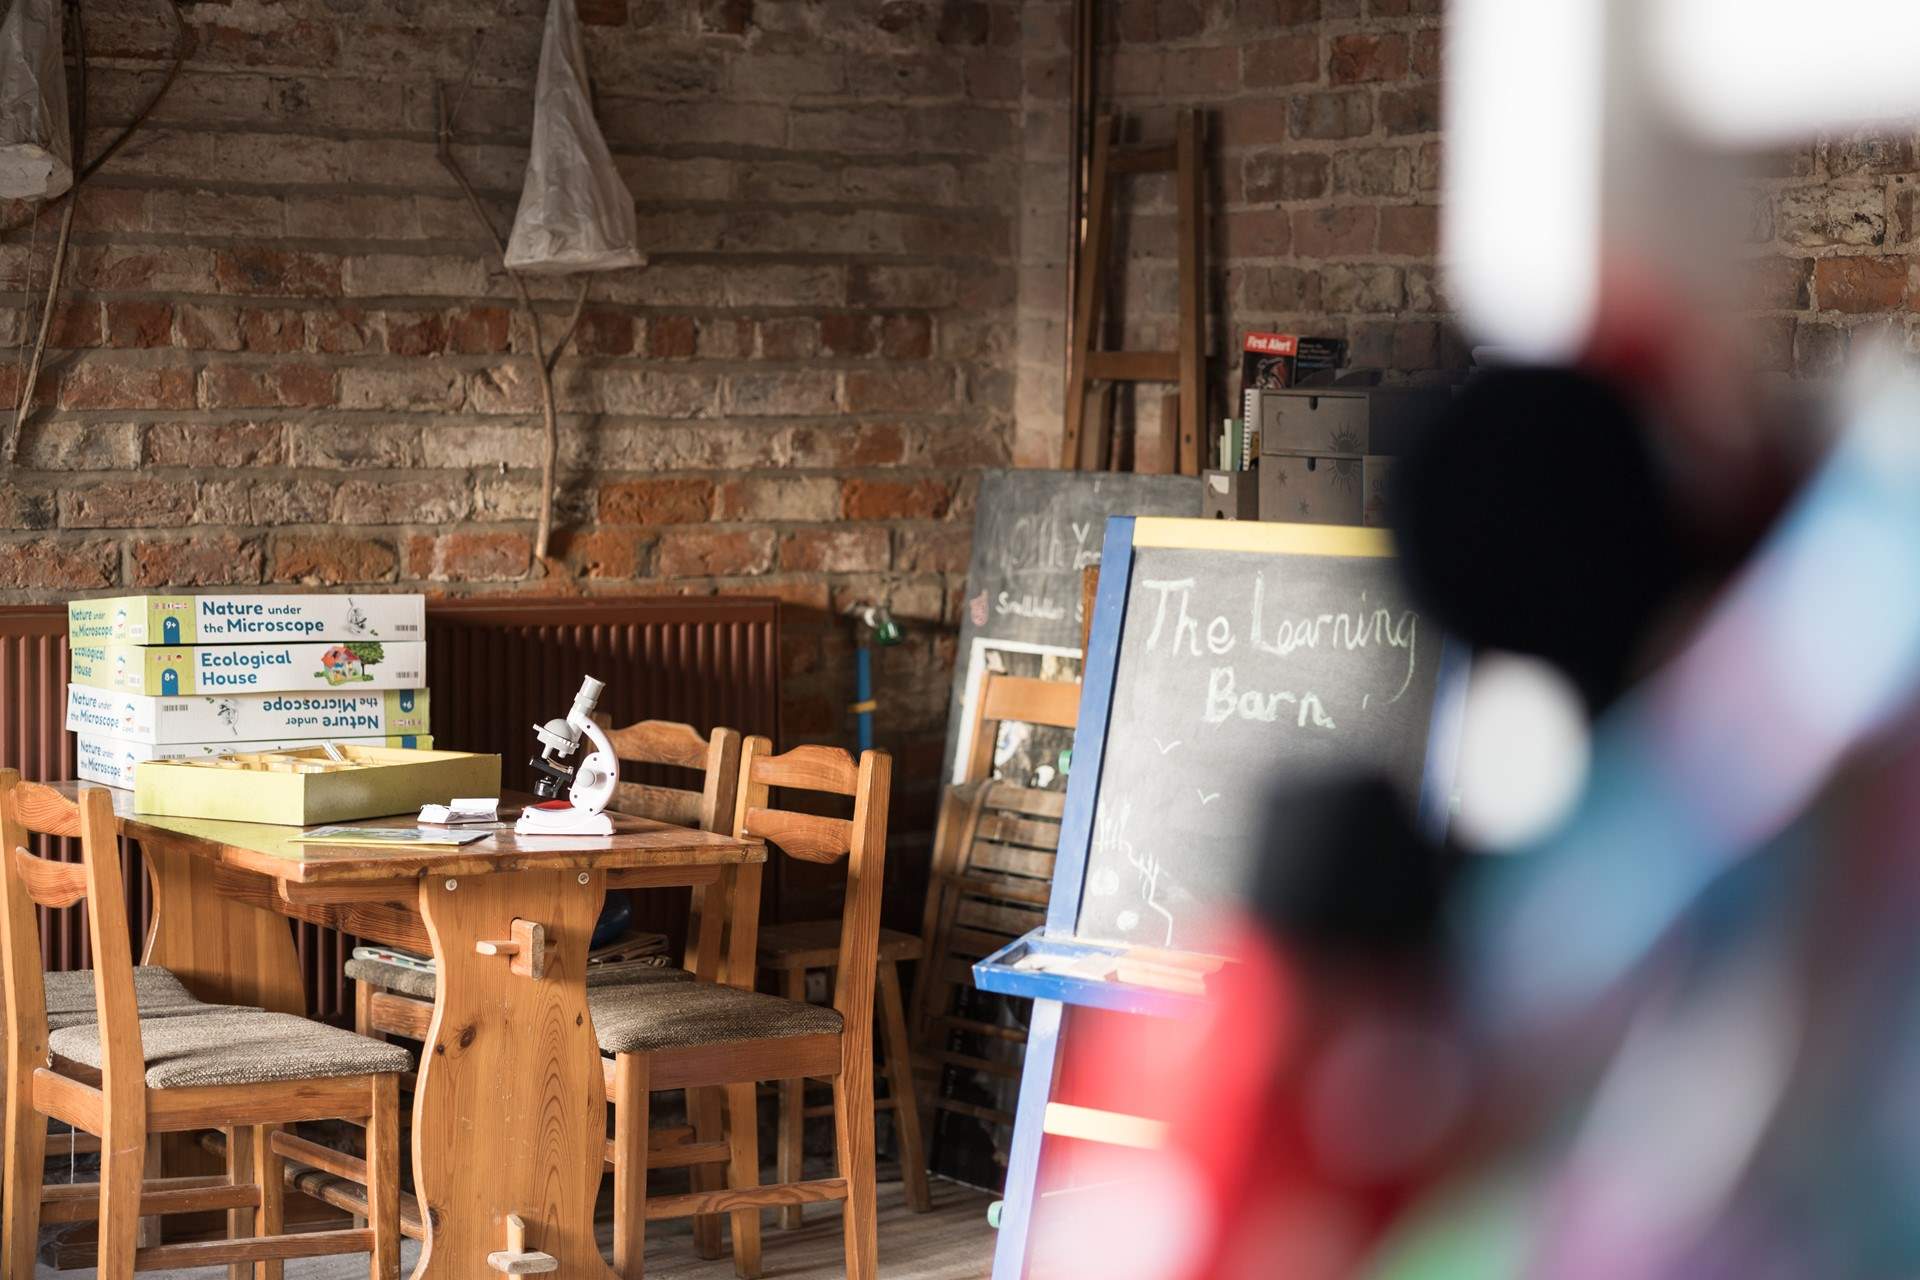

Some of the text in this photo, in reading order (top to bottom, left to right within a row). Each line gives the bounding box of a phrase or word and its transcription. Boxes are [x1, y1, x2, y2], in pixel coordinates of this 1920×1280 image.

[71, 609, 93, 621] Nature
[202, 601, 302, 616] Nature under
[79, 625, 113, 639] Microscope
[165, 620, 177, 630] 9+
[204, 618, 324, 635] the Microscope
[1142, 570, 1419, 704] The Learning
[201, 650, 292, 670] Ecological
[74, 662, 92, 677] House
[164, 672, 175, 682] 8+
[202, 672, 257, 686] House
[72, 691, 97, 708] Nature
[263, 696, 378, 713] the Microscope
[80, 709, 120, 730] Microscope
[286, 715, 379, 729] Nature under
[80, 740, 101, 756] Nature
[88, 757, 122, 778] Microscope
